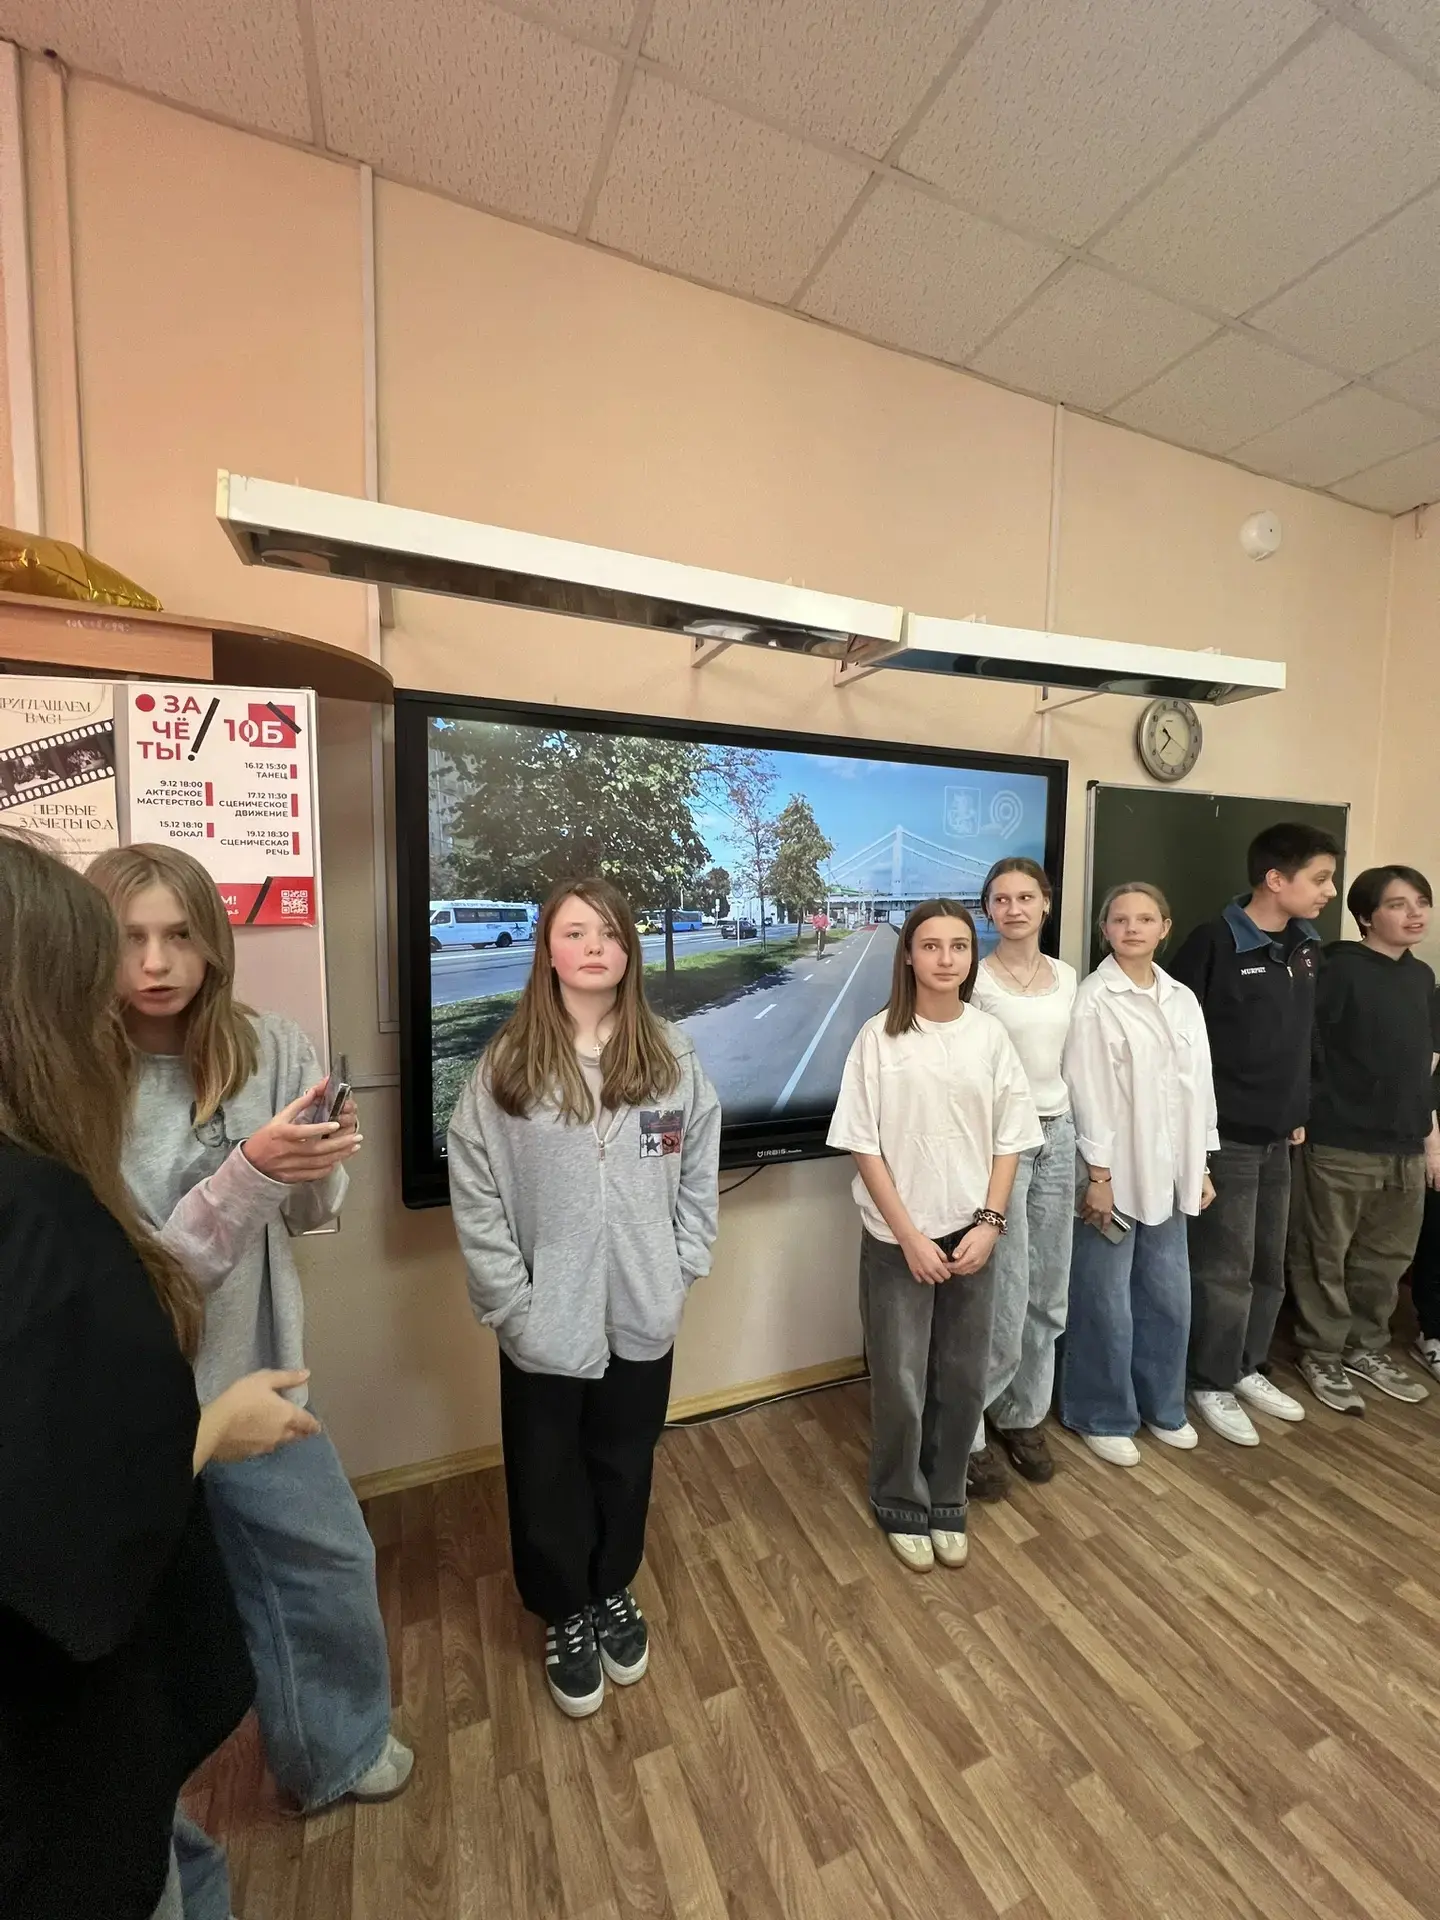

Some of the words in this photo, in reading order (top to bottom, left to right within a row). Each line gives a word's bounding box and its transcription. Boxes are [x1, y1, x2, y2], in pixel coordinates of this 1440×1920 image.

[0, 696, 91, 713] РИГЛАШАЕМ
[163, 694, 202, 715] ЗА
[152, 717, 191, 740] ЧЁ
[244, 761, 264, 770] 16.12
[265, 762, 287, 771] 15:30
[256, 771, 288, 780] ТАНЕЦ
[160, 780, 178, 788] 9.12
[179, 780, 203, 788] 18:00
[145, 788, 203, 797] АКТЕРСКОЕ
[267, 792, 288, 800] 11:30
[137, 797, 203, 807] МАСТЕРСТВО
[218, 800, 289, 809] СЦЕНИЧЕСКОЕ
[33, 803, 98, 816] ПЕРВЫЕ
[234, 809, 289, 818] ДВИЖЕНИЕ
[182, 821, 203, 829] 18:10
[169, 830, 203, 838] ВОКАЛ
[220, 838, 290, 847] СЦЕНИЧЕСКАЯ
[265, 848, 290, 857] РЕЧЬ
